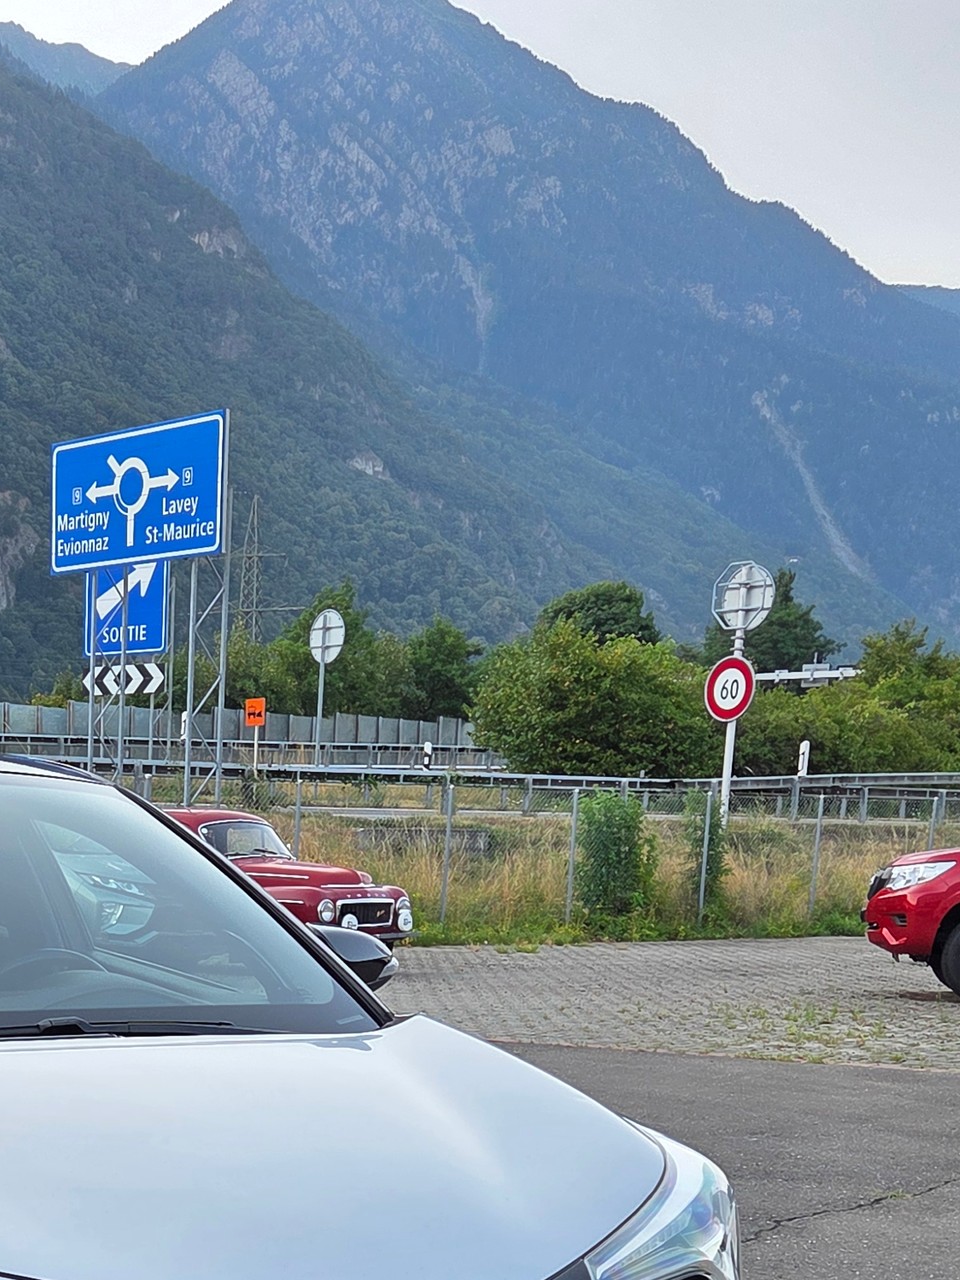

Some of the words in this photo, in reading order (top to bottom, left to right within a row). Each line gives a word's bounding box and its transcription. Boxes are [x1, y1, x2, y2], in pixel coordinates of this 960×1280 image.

[162, 496, 199, 516] Lavey
[57, 509, 110, 532] Martigny
[145, 518, 214, 544] St-Maurice
[57, 537, 109, 556] Evionnaz
[720, 679, 739, 700] 60
